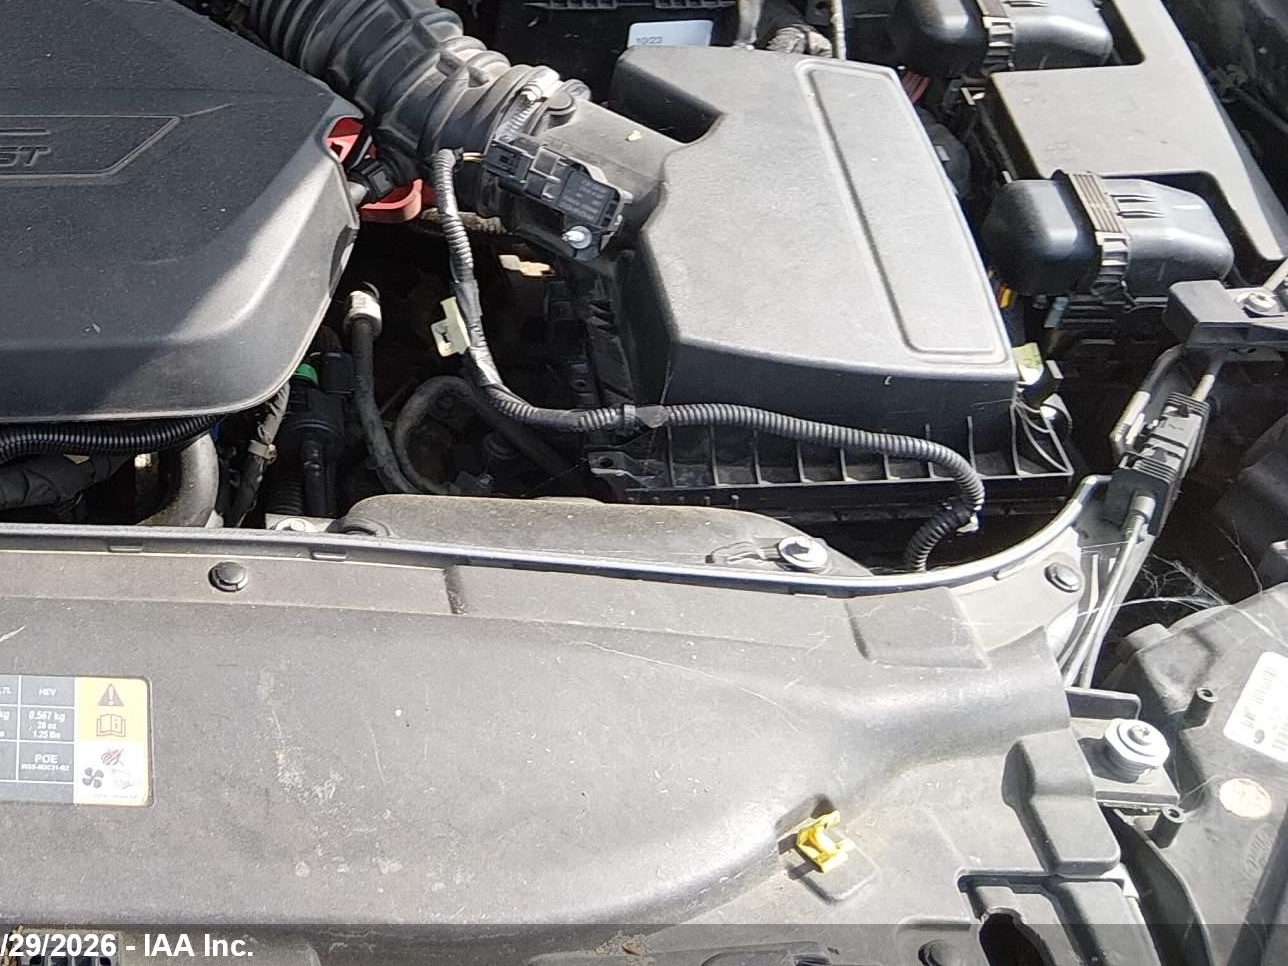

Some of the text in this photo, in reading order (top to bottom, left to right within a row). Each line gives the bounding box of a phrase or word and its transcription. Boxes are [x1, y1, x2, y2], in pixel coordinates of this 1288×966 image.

[38, 688, 57, 696] HEV
[28, 710, 66, 723] 0.567 kg
[34, 753, 59, 764] POE
